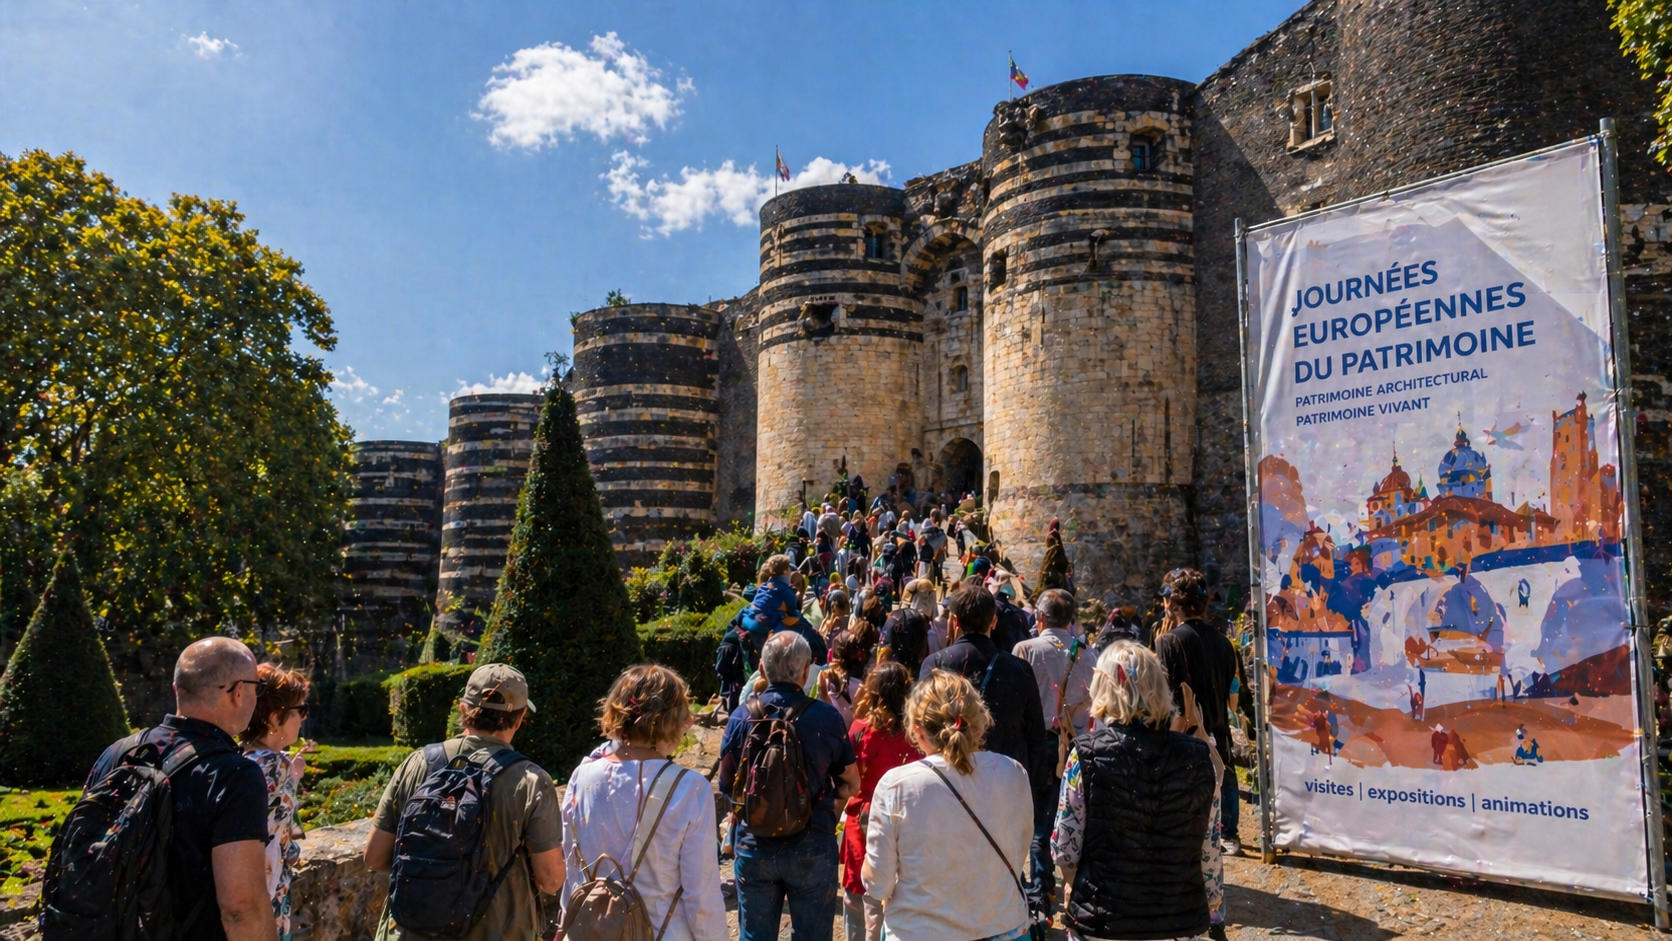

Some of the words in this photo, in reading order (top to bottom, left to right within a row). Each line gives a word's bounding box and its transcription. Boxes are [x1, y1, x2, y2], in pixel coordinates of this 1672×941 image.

[1291, 260, 1439, 317] JOURNÉES
[1293, 281, 1527, 349] EUROPÉENNES
[1294, 355, 1333, 384] DU
[1341, 319, 1536, 376] PATRIMOINE
[1295, 385, 1374, 408] PATRIMOINE
[1376, 367, 1489, 396] ARCHITECTURAL
[1296, 404, 1376, 427] PATRIMOINE
[1378, 396, 1431, 415] VIVANT
[1304, 779, 1354, 797] visites
[1367, 786, 1466, 808] expositions
[1481, 796, 1590, 821] animations
